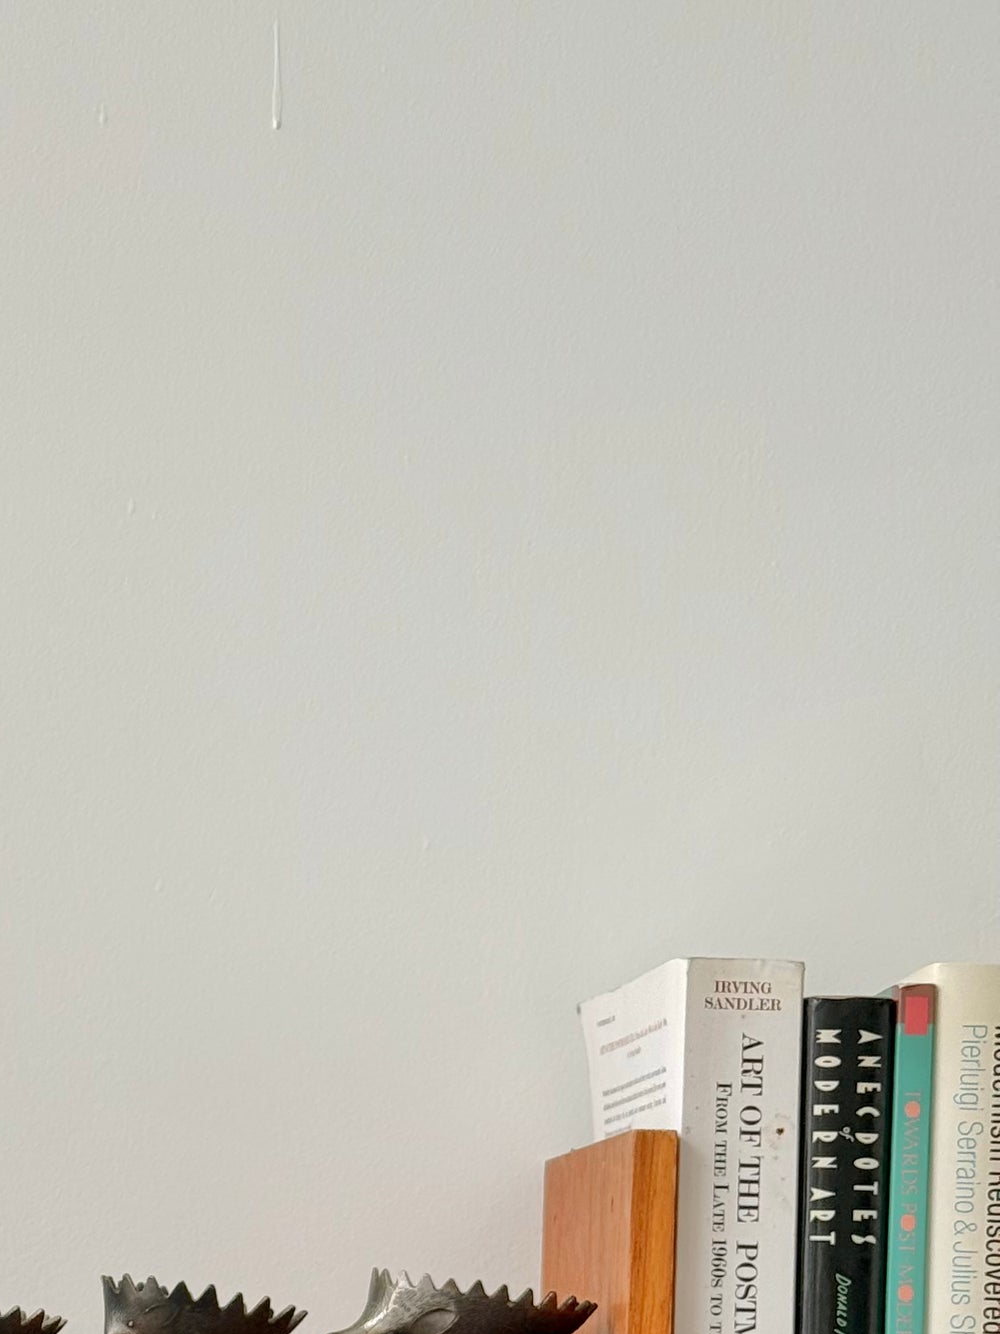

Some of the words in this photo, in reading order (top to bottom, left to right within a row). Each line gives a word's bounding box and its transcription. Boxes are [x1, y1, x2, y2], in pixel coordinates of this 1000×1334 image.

[704, 997, 782, 1011] SANDLER
[714, 980, 772, 994] IRVING
[740, 1032, 764, 1096] ART
[953, 1025, 988, 1111] Pierluigi
[714, 1081, 733, 1135] FROM
[811, 1028, 843, 1169] MODERN
[988, 1025, 1000, 1162] ernism
[739, 1105, 762, 1148] OF
[838, 1126, 854, 1143] of
[850, 1028, 884, 1245] ANECDOTES
[713, 1140, 728, 1177] THE
[954, 1121, 984, 1214] Serraino
[712, 1183, 729, 1233] LATE
[736, 1155, 761, 1223] THE
[808, 1187, 837, 1246] ART
[953, 1220, 978, 1236] &
[710, 1239, 728, 1288] 1960s
[951, 1241, 979, 1305] Julius
[710, 1293, 722, 1316] TO
[835, 1272, 852, 1327] DONALD
